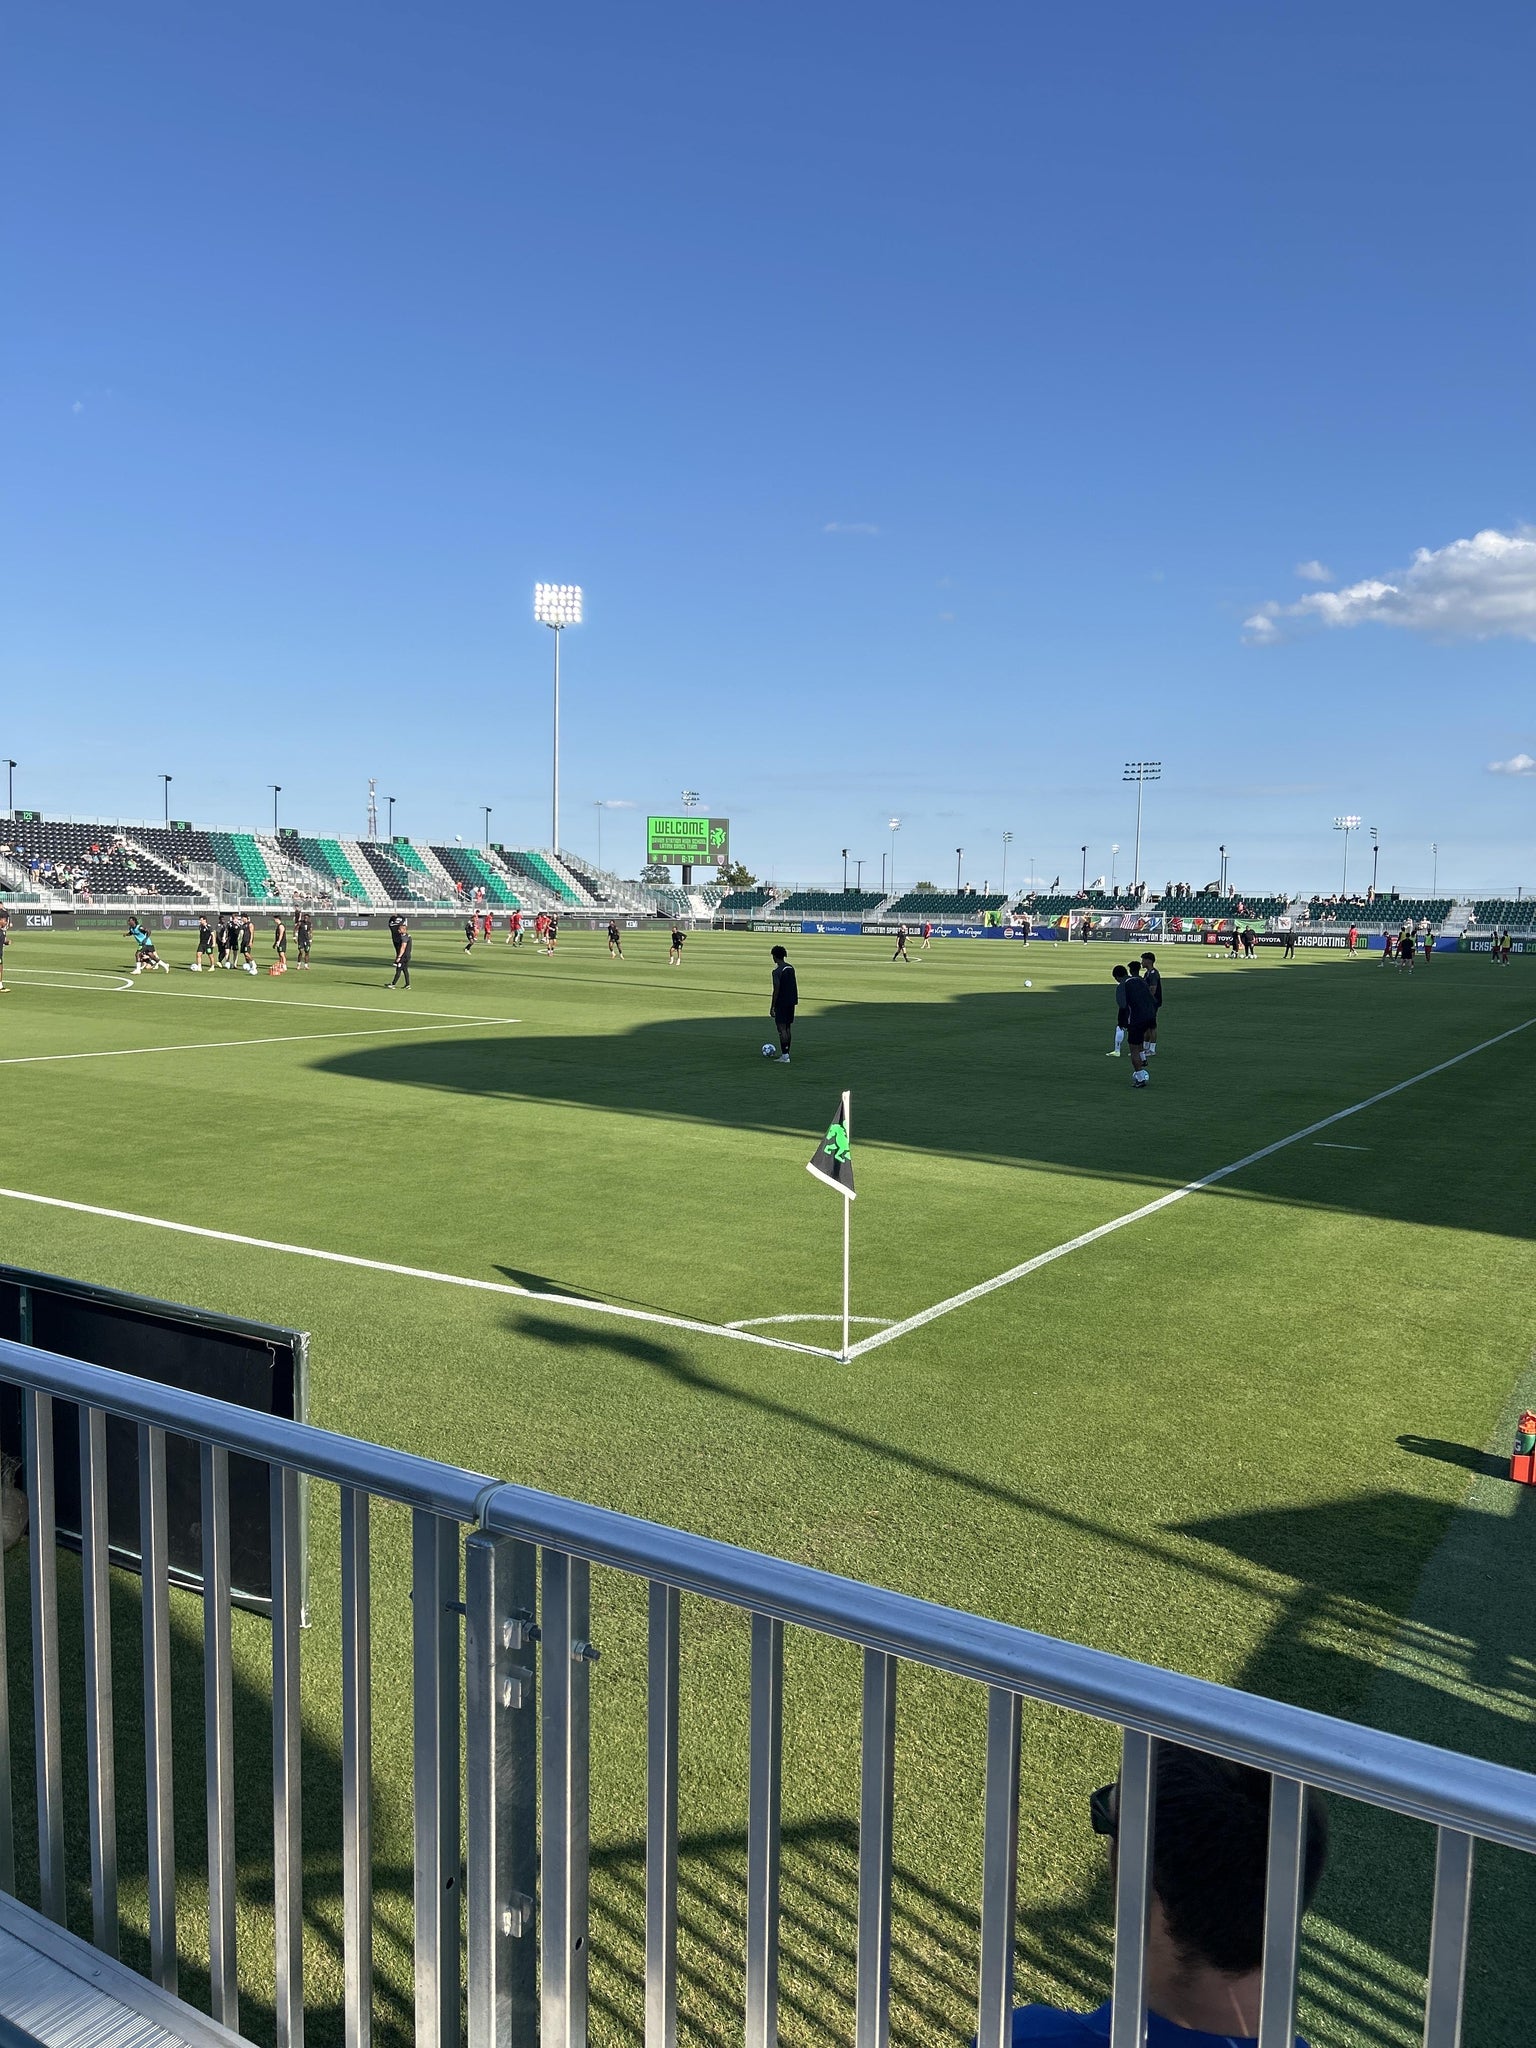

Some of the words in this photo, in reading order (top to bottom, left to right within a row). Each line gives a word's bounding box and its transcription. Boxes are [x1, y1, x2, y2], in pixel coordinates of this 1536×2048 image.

[655, 820, 704, 835] WELCOME
[26, 915, 53, 926] KEMI
[862, 926, 886, 934] LEXINGTON
[908, 927, 921, 935] CLUB
[935, 926, 952, 937] Kroger
[964, 927, 982, 938] Kroger
[1187, 934, 1202, 942] CLUB
